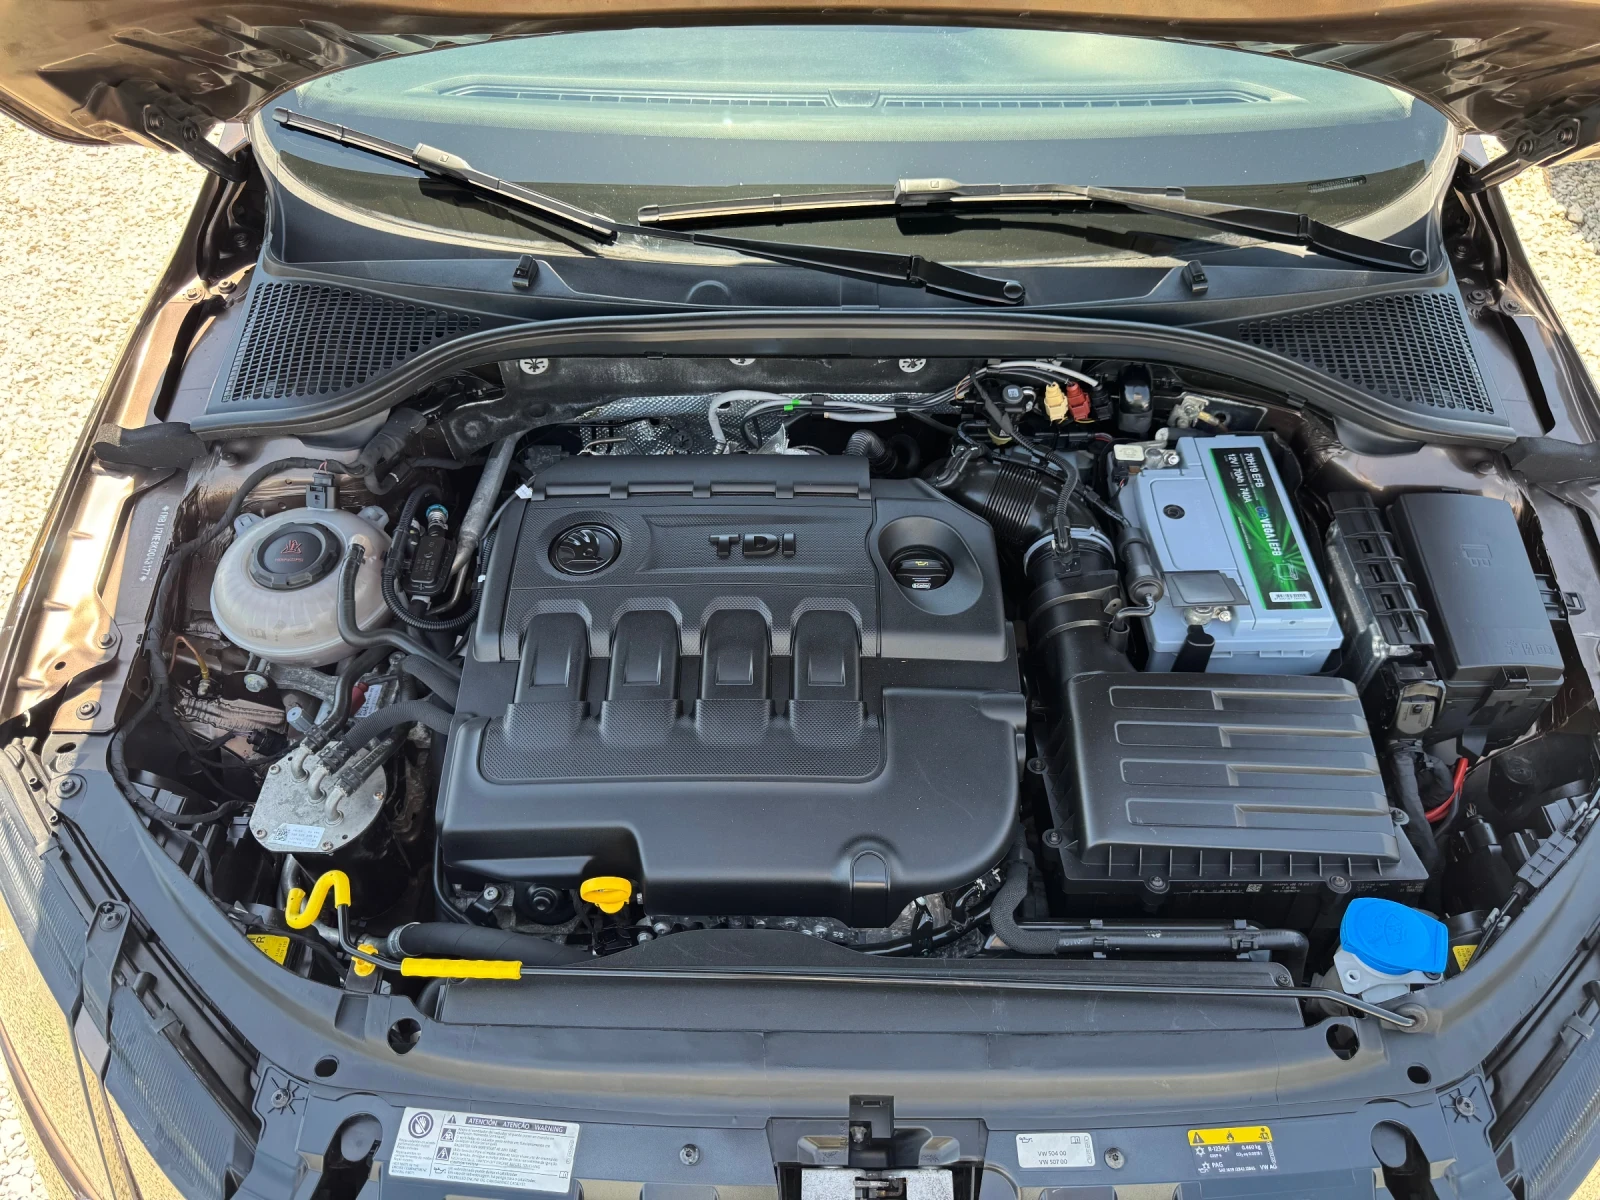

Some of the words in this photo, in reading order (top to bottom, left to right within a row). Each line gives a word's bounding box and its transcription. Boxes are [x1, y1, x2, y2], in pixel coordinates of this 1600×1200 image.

[1228, 453, 1239, 465] 12V
[1233, 468, 1245, 483] 70Ah
[1252, 473, 1265, 488] EFB
[1240, 487, 1253, 503] 740A
[708, 532, 797, 557] TDI
[467, 1117, 498, 1127] ATENCIÓN
[534, 1123, 564, 1133] WARNING
